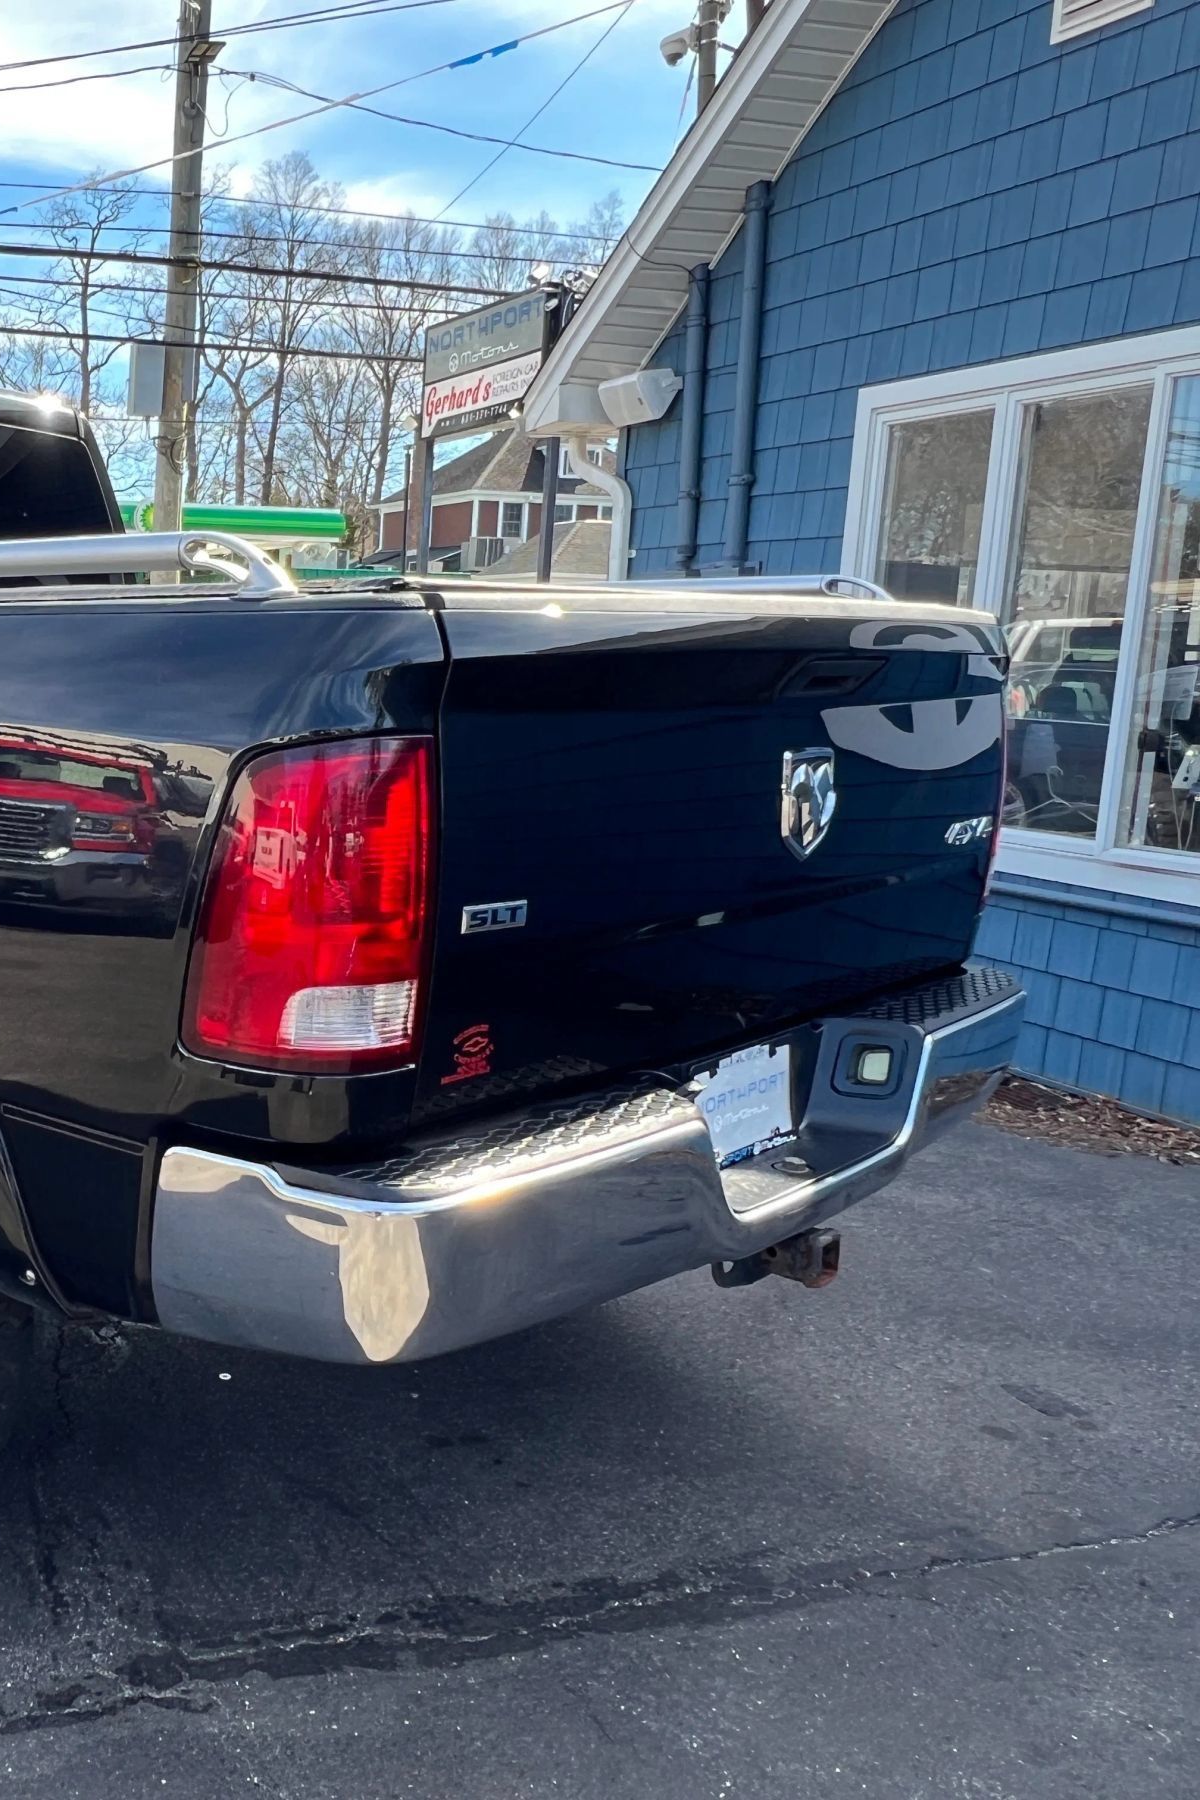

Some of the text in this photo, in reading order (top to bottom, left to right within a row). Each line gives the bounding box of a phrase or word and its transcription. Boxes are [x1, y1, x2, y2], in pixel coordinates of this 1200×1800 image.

[429, 297, 544, 353] NORTHPORT
[426, 374, 492, 427] Gerhard's
[468, 905, 523, 928] SLT
[702, 1071, 786, 1114] ORTHPORT
